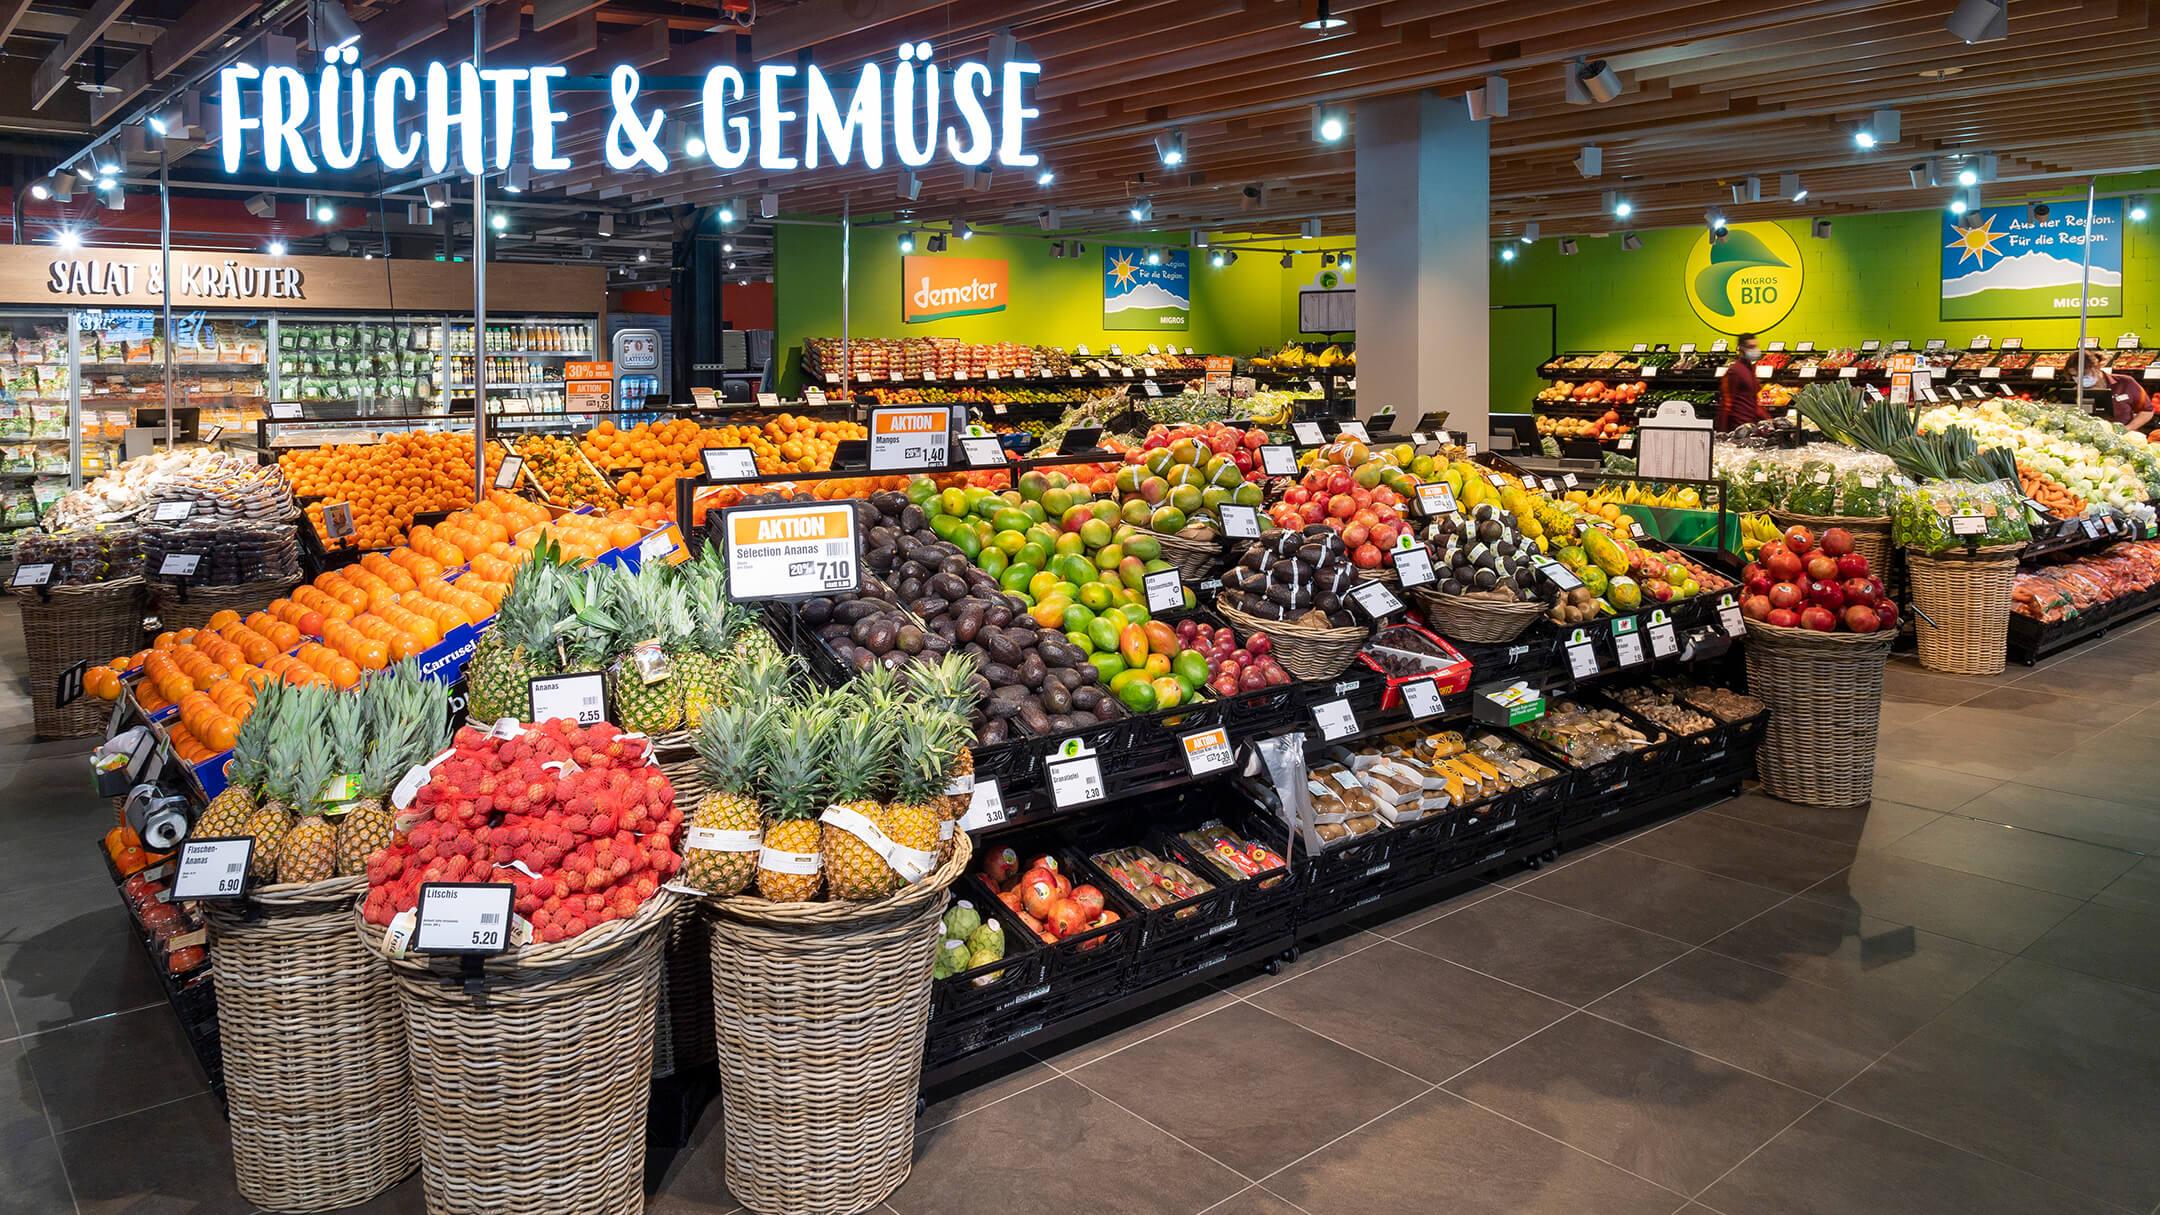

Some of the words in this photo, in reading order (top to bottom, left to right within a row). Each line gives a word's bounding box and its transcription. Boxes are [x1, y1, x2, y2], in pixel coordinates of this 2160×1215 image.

[220, 45, 572, 175] FRÜCHTE
[605, 64, 670, 173] &
[702, 41, 1042, 170] GEMÜSE
[2009, 235, 2031, 246] Für
[2035, 235, 2054, 245] die
[2058, 232, 2109, 246] Regon.
[49, 259, 139, 296] SALAT
[147, 262, 164, 294] &
[181, 259, 306, 299] KRÄUTER
[1741, 277, 1778, 285] MIGROS
[914, 276, 998, 309] demeter
[1741, 286, 1778, 304] BIO
[2053, 297, 2109, 308] MIGOS
[1159, 316, 1185, 324] MIGROS
[568, 364, 594, 377] 30%
[576, 384, 602, 393] AKTION
[890, 415, 932, 431] AKTION
[876, 436, 900, 444] Mangos
[922, 447, 944, 461] 1.40
[758, 516, 825, 540] AKTION
[784, 544, 819, 556] Ananas
[816, 560, 850, 580] 7.10
[422, 638, 477, 674] Carrusel
[535, 683, 559, 691] Ananas
[579, 710, 600, 722] 2.55
[1193, 735, 1217, 749] AKTION
[1085, 788, 1100, 799] 2.30
[986, 809, 1003, 822] 3.30
[187, 845, 218, 854] Flaschen-
[185, 857, 208, 865] Ananas
[218, 878, 240, 892] 6.90
[427, 889, 458, 899] Litschis
[472, 931, 498, 945] 5.20
